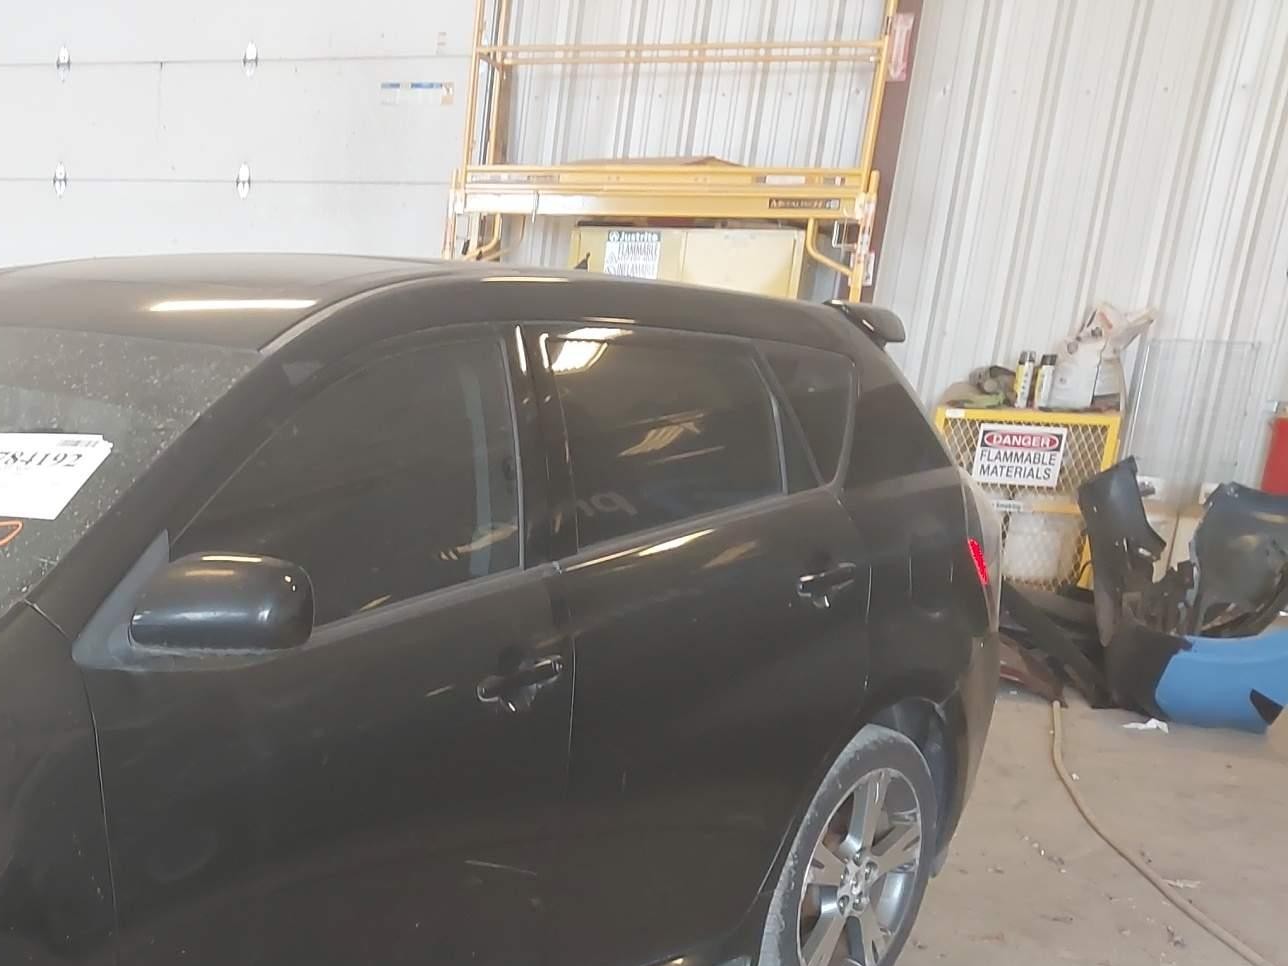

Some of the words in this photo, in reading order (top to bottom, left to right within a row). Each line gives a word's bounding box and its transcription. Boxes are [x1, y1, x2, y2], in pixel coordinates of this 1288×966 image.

[992, 434, 1051, 448] DANGER
[979, 449, 1057, 466] FLAMMABLE
[979, 464, 1052, 481] MATERIALS
